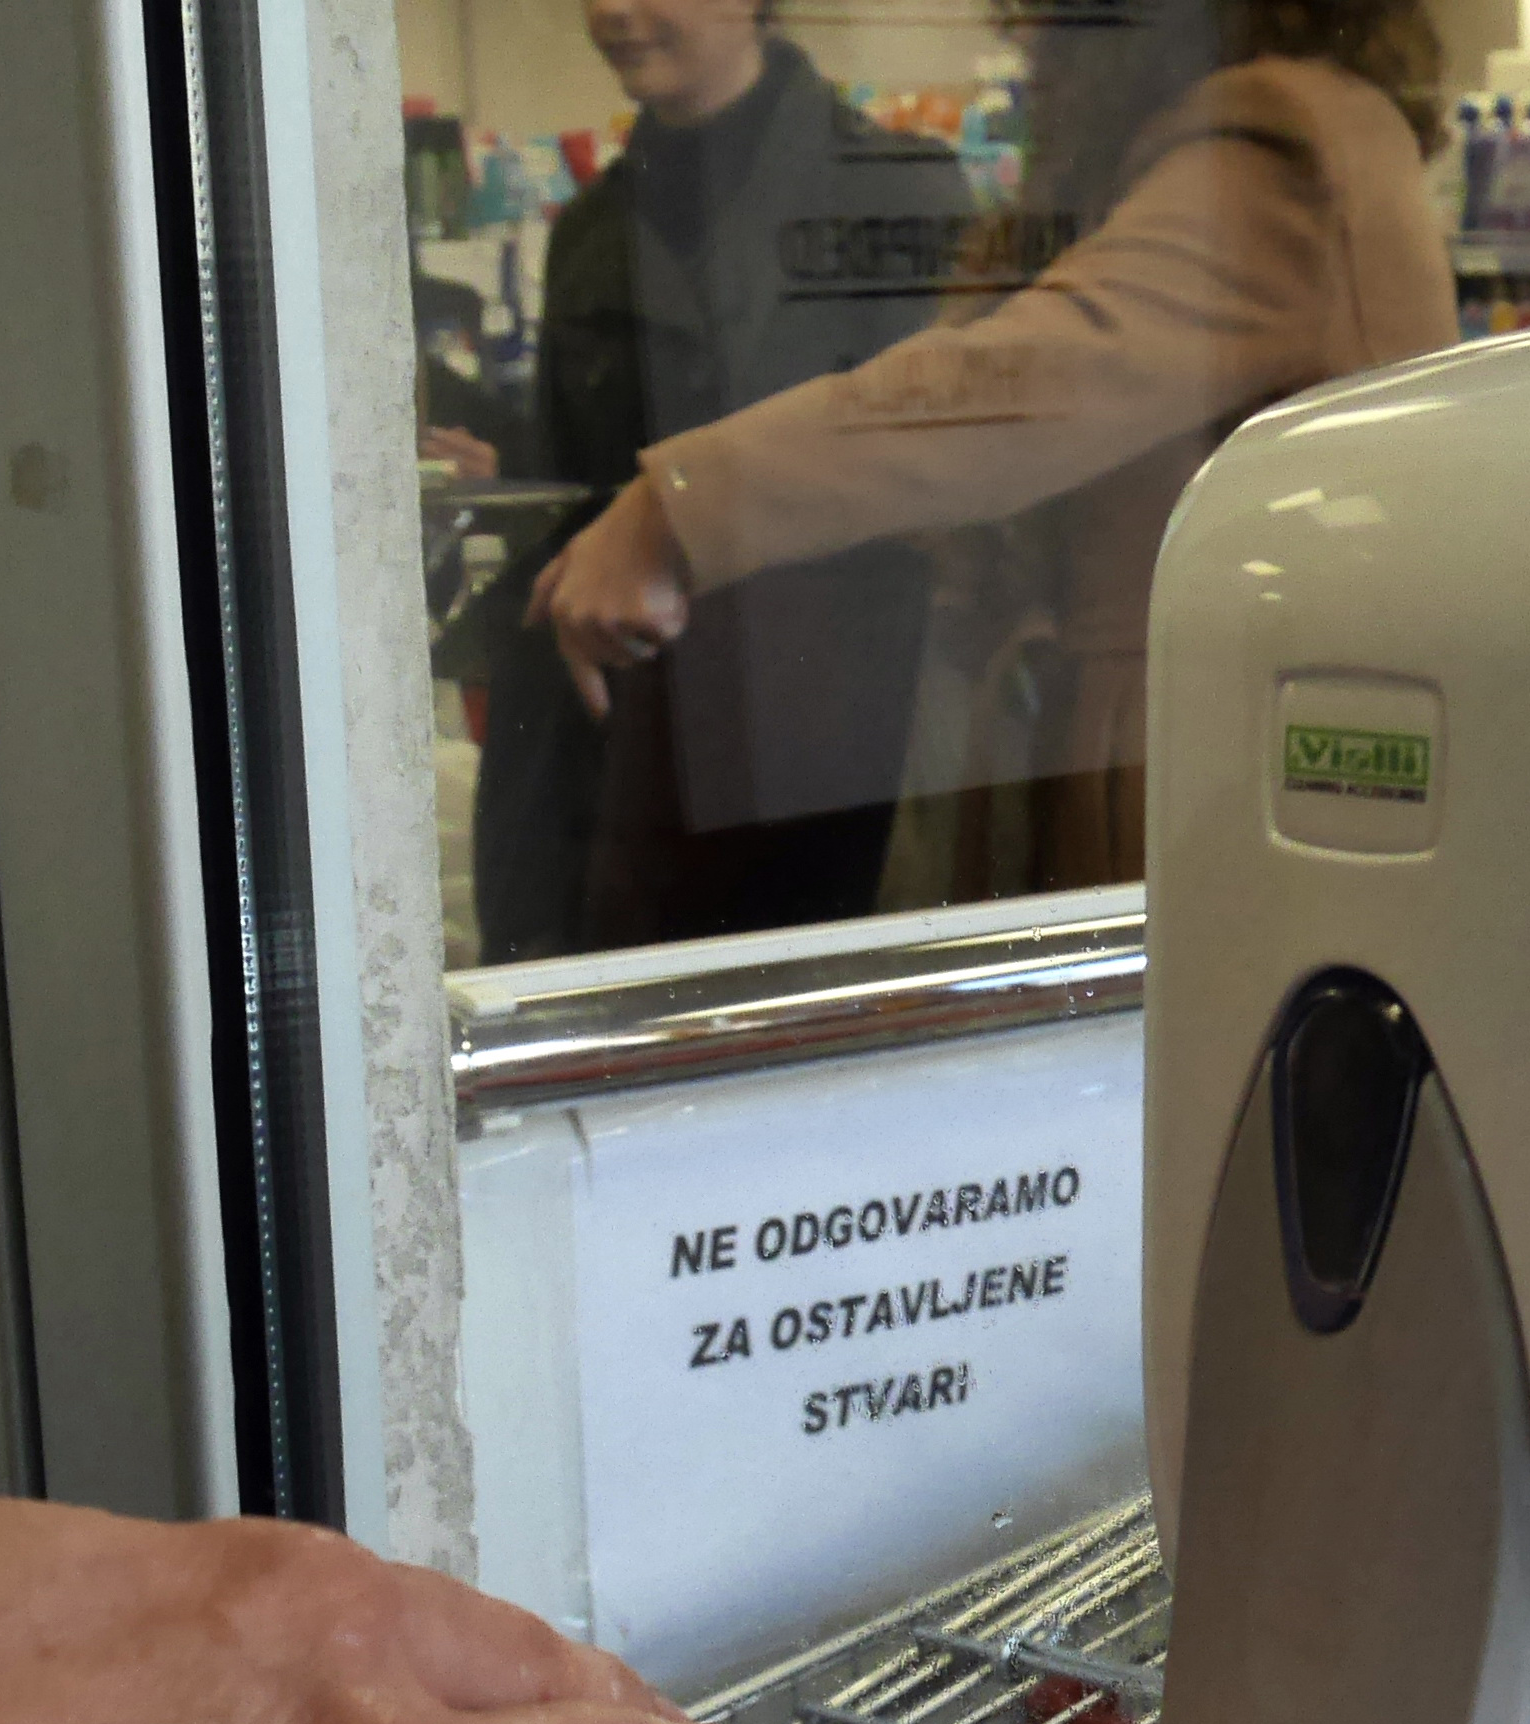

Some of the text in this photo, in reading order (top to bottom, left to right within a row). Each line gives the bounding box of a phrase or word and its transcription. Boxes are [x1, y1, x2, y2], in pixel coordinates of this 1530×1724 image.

[671, 1166, 1080, 1278] NE ODGOVARAMO
[690, 1256, 1067, 1369] ZA OSTAVLJENE
[804, 1364, 968, 1435] STVARI
